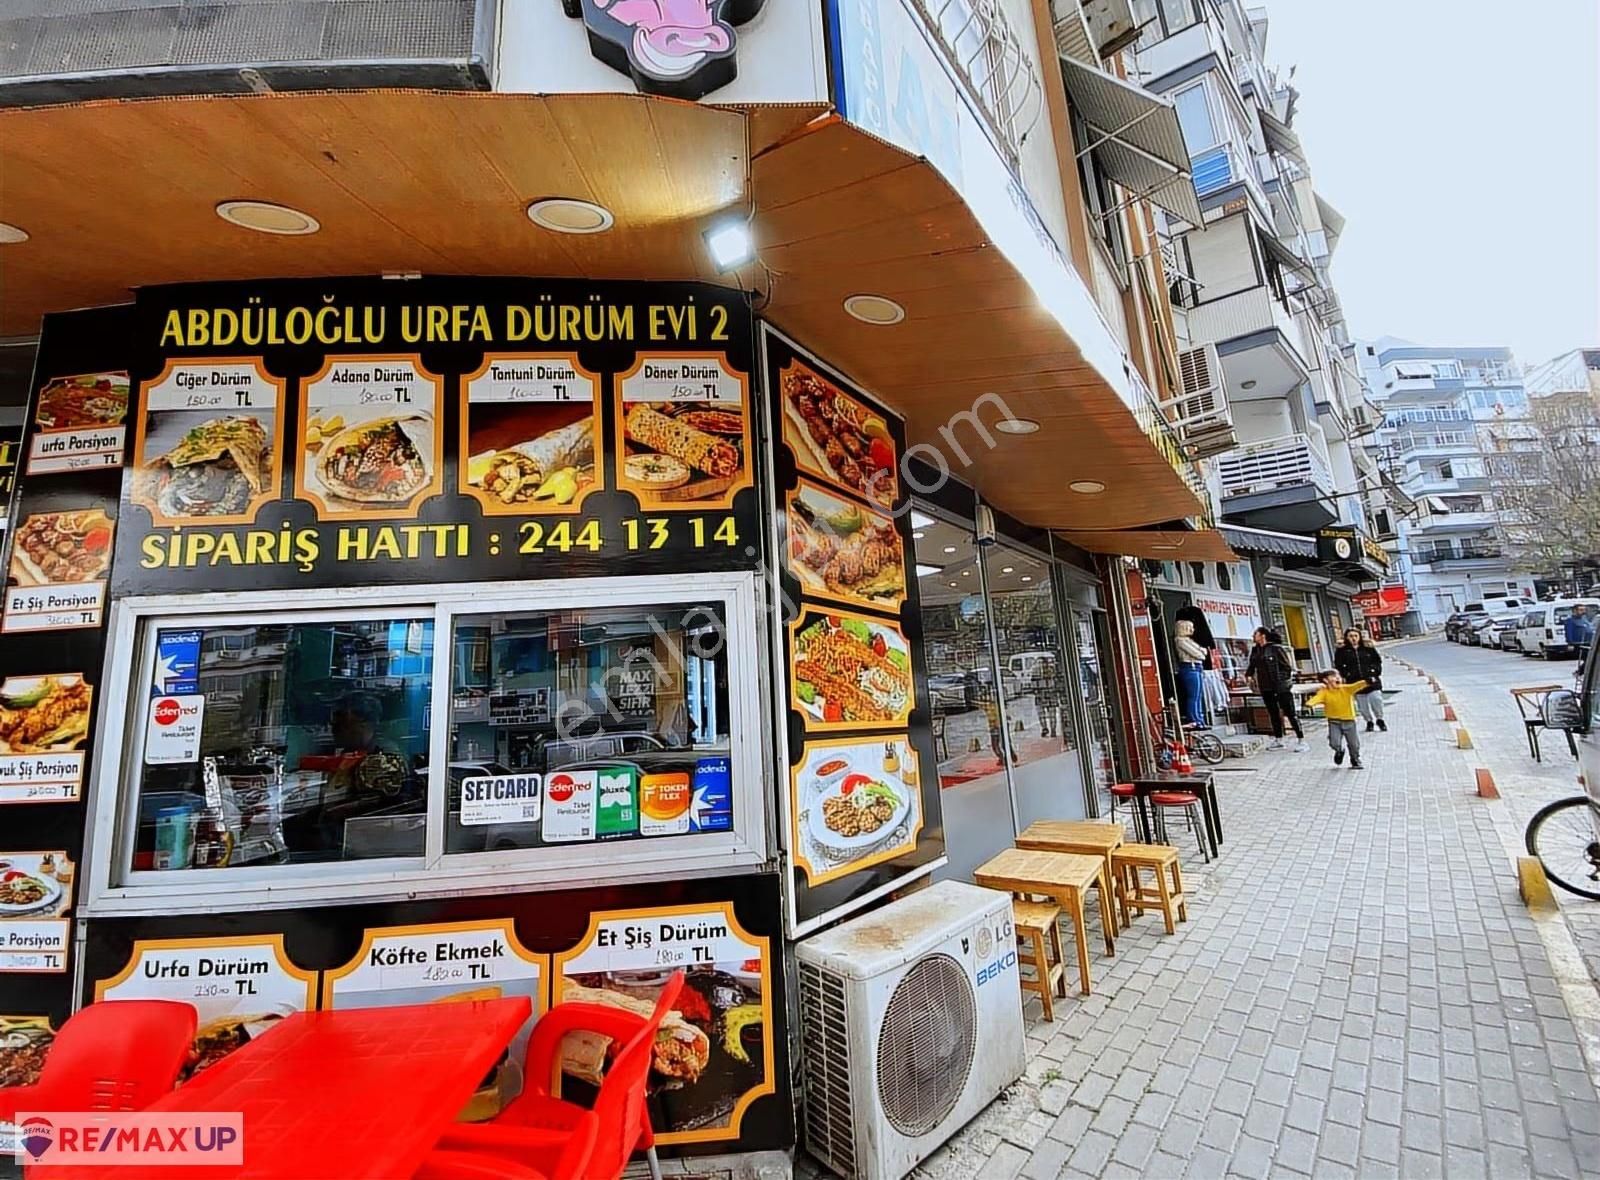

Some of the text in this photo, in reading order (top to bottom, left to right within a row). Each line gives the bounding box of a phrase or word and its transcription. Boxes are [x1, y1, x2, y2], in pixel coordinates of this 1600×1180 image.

[160, 294, 730, 347] ABDÜLOĞLU URFA DÜRÜM EVİ 2
[175, 371, 252, 388] Ciğer Dürüm
[332, 369, 414, 384] Adana Dürüm
[491, 366, 576, 380] Tantuni Dürüm
[644, 365, 719, 379] Döner Dürüm
[235, 391, 253, 406] TL
[394, 387, 411, 403] TL
[553, 385, 570, 400] TL
[703, 384, 720, 399] TL
[41, 434, 117, 452] urfa Porsiyon
[103, 454, 118, 464] TL
[140, 516, 740, 573] SİPARİŞ HATTI : 244 13 14
[12, 594, 97, 611] Et Şiş Porsiyon
[80, 612, 96, 623] TL
[619, 670, 652, 683] MAX
[619, 696, 651, 709] SIFIR
[154, 704, 198, 717] Edenred
[19, 761, 33, 780] Şiş
[36, 760, 78, 777] Porsiyon
[62, 785, 77, 797] TL
[464, 777, 539, 801] SETCARD
[549, 781, 592, 793] Edenred
[659, 783, 689, 793] TOKEN
[659, 792, 681, 800] FLEX
[597, 922, 727, 950] Et Şiş Dürüm
[995, 920, 1012, 943] LG
[9, 932, 60, 948] Porsiyon
[43, 954, 60, 967] TL
[370, 939, 504, 967] Köfte Ekmek
[692, 946, 714, 962] TL
[144, 958, 268, 978] Urfa Dürüm
[468, 963, 491, 979] TL
[976, 951, 1016, 987] BEKO
[235, 980, 257, 995] TL
